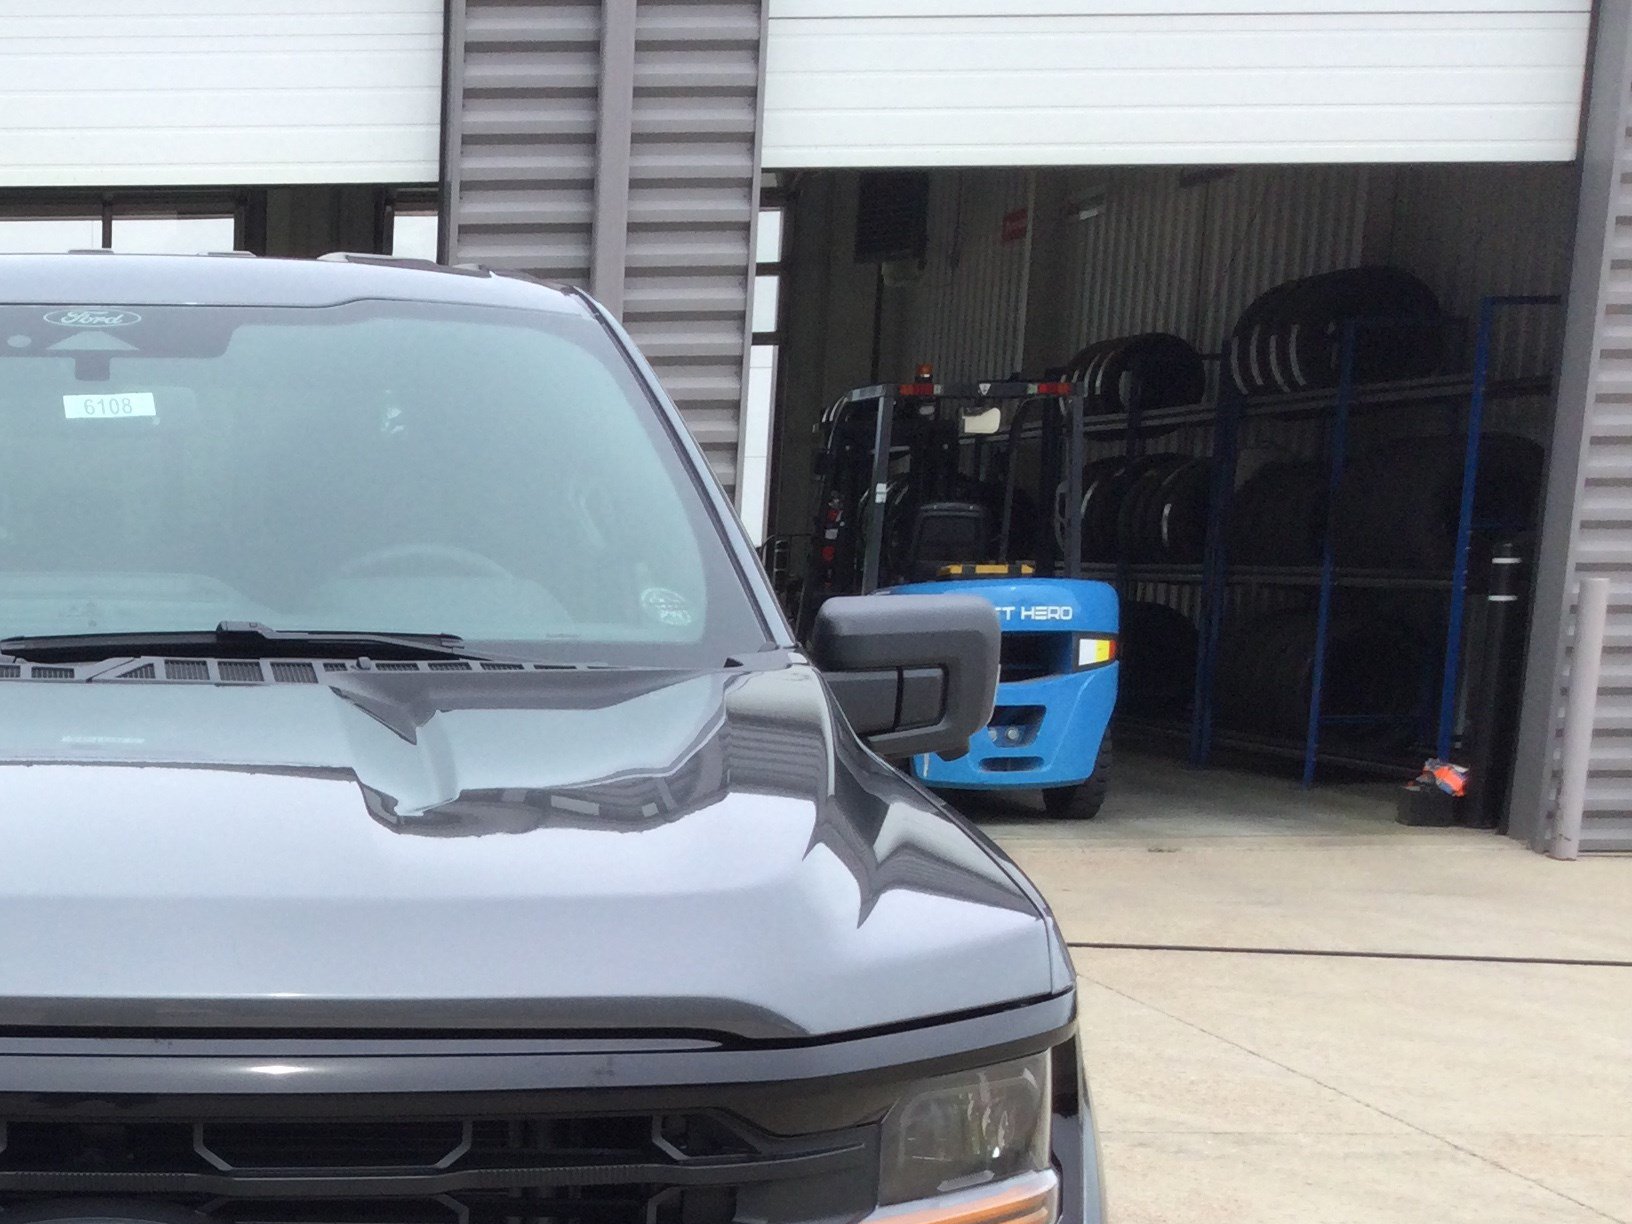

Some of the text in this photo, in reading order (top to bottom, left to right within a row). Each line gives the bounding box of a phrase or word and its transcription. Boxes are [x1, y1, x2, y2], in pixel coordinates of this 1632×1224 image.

[60, 310, 124, 325] Ford
[83, 398, 133, 416] 6108
[1020, 606, 1073, 621] HERO
